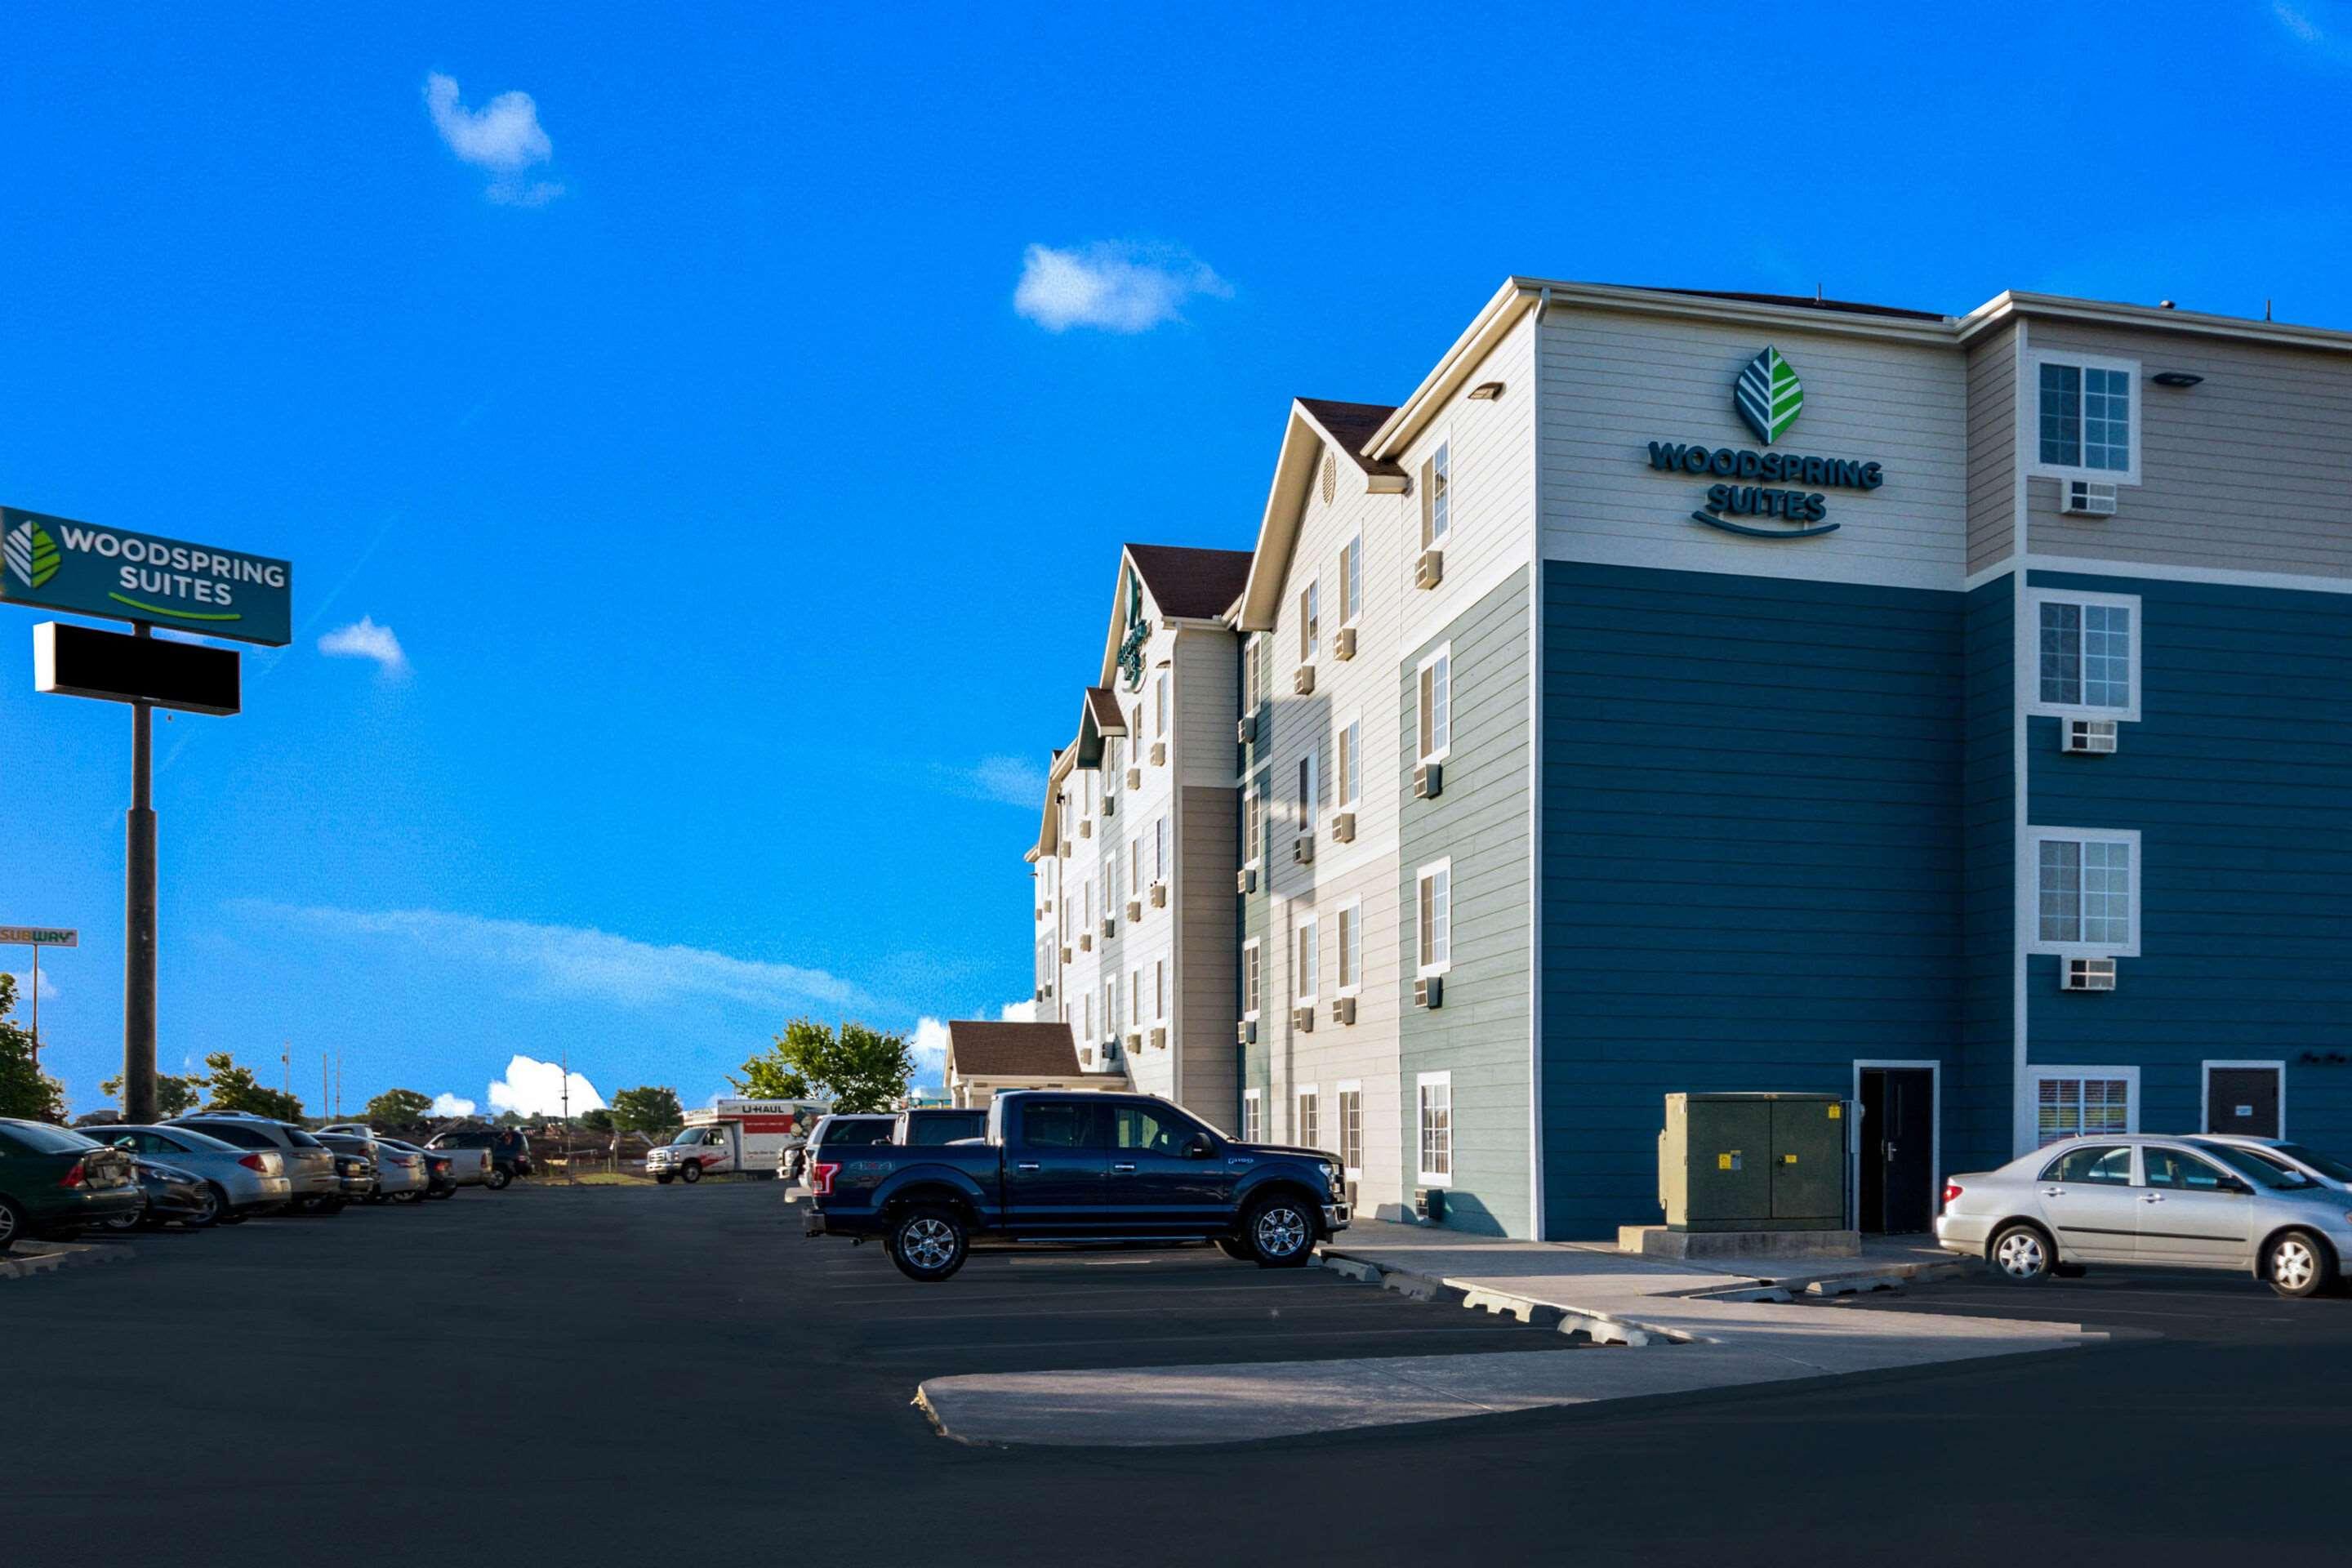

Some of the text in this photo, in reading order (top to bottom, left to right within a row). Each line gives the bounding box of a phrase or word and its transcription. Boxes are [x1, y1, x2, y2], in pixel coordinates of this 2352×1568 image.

[1647, 441, 1883, 491] WOODSPRING
[1705, 483, 1827, 522] SUITES
[60, 524, 285, 588] WOODSPRING
[119, 565, 233, 606] SUITES
[0, 929, 74, 942] SUBWAY
[742, 1105, 784, 1113] U-HAUL
